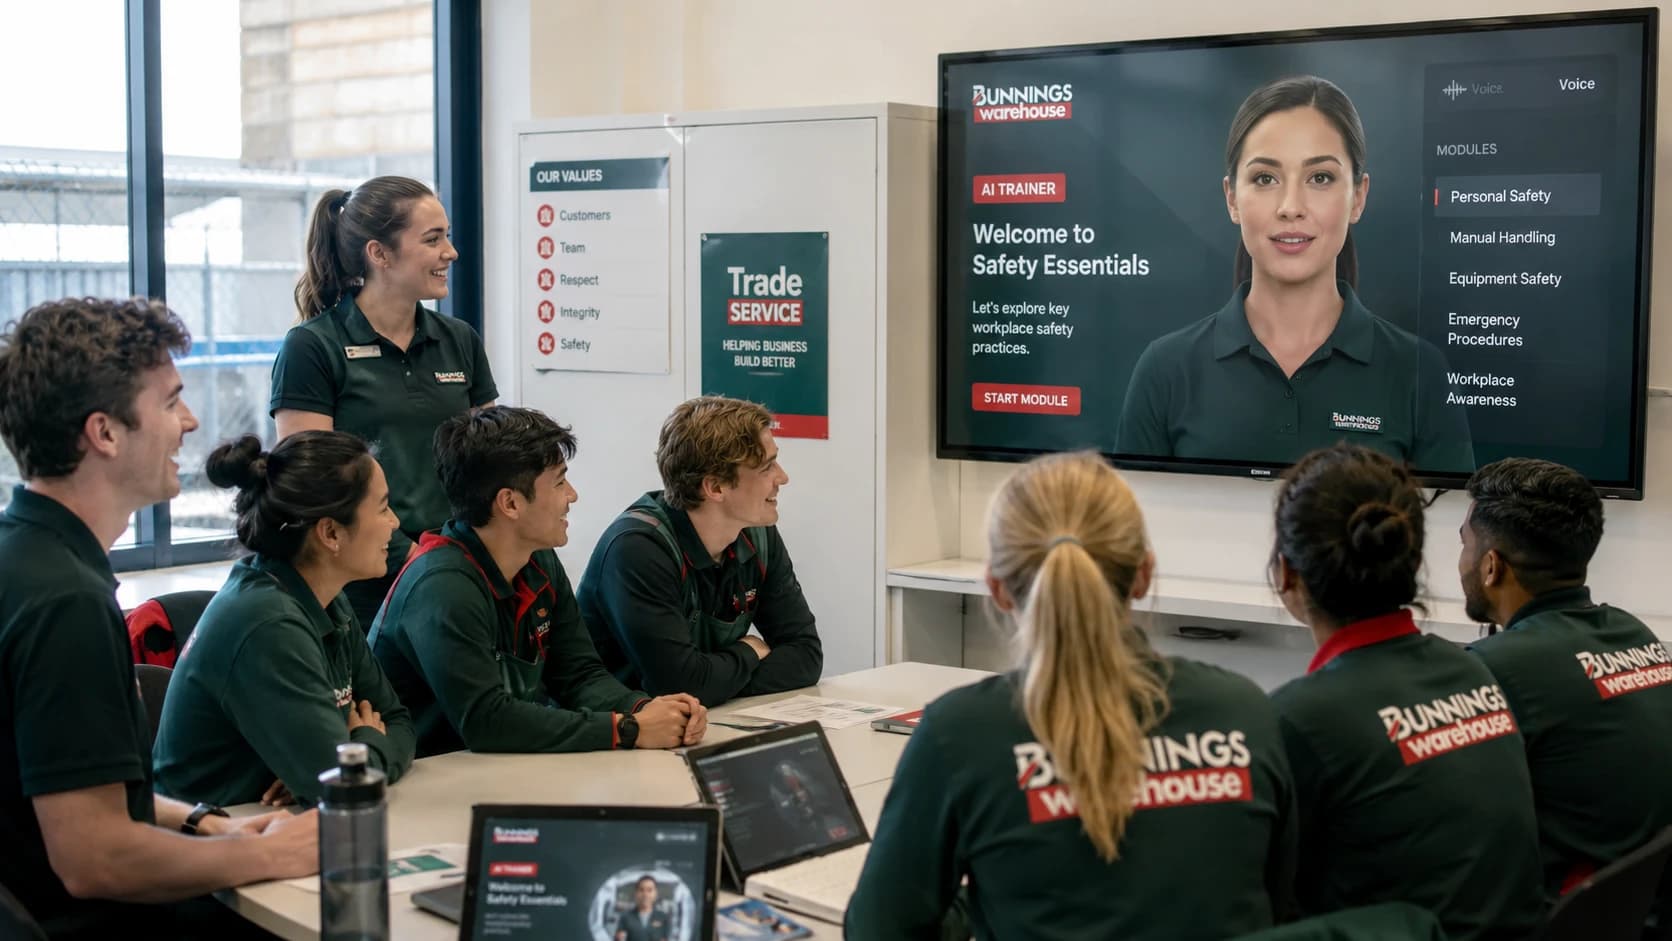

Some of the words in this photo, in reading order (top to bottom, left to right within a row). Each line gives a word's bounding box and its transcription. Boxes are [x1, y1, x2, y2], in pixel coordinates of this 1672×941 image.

[1559, 78, 1596, 91] Voice
[972, 84, 1073, 106] BUNNINGS
[980, 103, 1066, 121] warehouse
[1436, 143, 1498, 156] MODULES
[536, 170, 560, 183] OUR
[561, 168, 603, 183] VALUES
[981, 182, 995, 196] AI
[998, 182, 1056, 196] TRAINER
[1451, 190, 1507, 203] Personal
[1510, 189, 1551, 204] Safety
[560, 210, 611, 222] Customers
[972, 223, 1068, 244] Welcome
[1073, 224, 1095, 244] to
[1450, 231, 1495, 244] Manual
[1499, 230, 1556, 246] Handling
[560, 242, 586, 253] Team
[972, 254, 1038, 280] Safety
[1043, 254, 1150, 276] Essentials
[560, 274, 599, 288] Respect
[727, 265, 803, 297] Trade
[1449, 272, 1517, 287] Equipment
[1520, 272, 1562, 287] Safety
[560, 306, 601, 320] Integrity
[730, 302, 801, 323] SERVICE
[972, 300, 1000, 314] Let's
[1002, 301, 1046, 316] explore
[1048, 302, 1070, 318] key
[1448, 313, 1520, 328] Emergency
[972, 321, 1033, 336] workplace
[1036, 322, 1074, 338] safety
[560, 338, 591, 352] Safety
[722, 340, 761, 351] HELPING
[763, 341, 808, 353] BUSINESS
[1448, 333, 1523, 346] Procedures
[972, 341, 1030, 356] practices.
[734, 355, 760, 367] BUILD
[762, 356, 796, 368] BETTER
[1447, 373, 1515, 388] Workplace
[984, 392, 1018, 404] START
[1021, 394, 1068, 406] MODULE
[1446, 392, 1517, 406] Awareness
[1378, 684, 1508, 743] BUNNINGS
[1406, 714, 1513, 759] warehouse
[1013, 730, 1252, 791] BINGS
[1040, 769, 1243, 817] whouse
